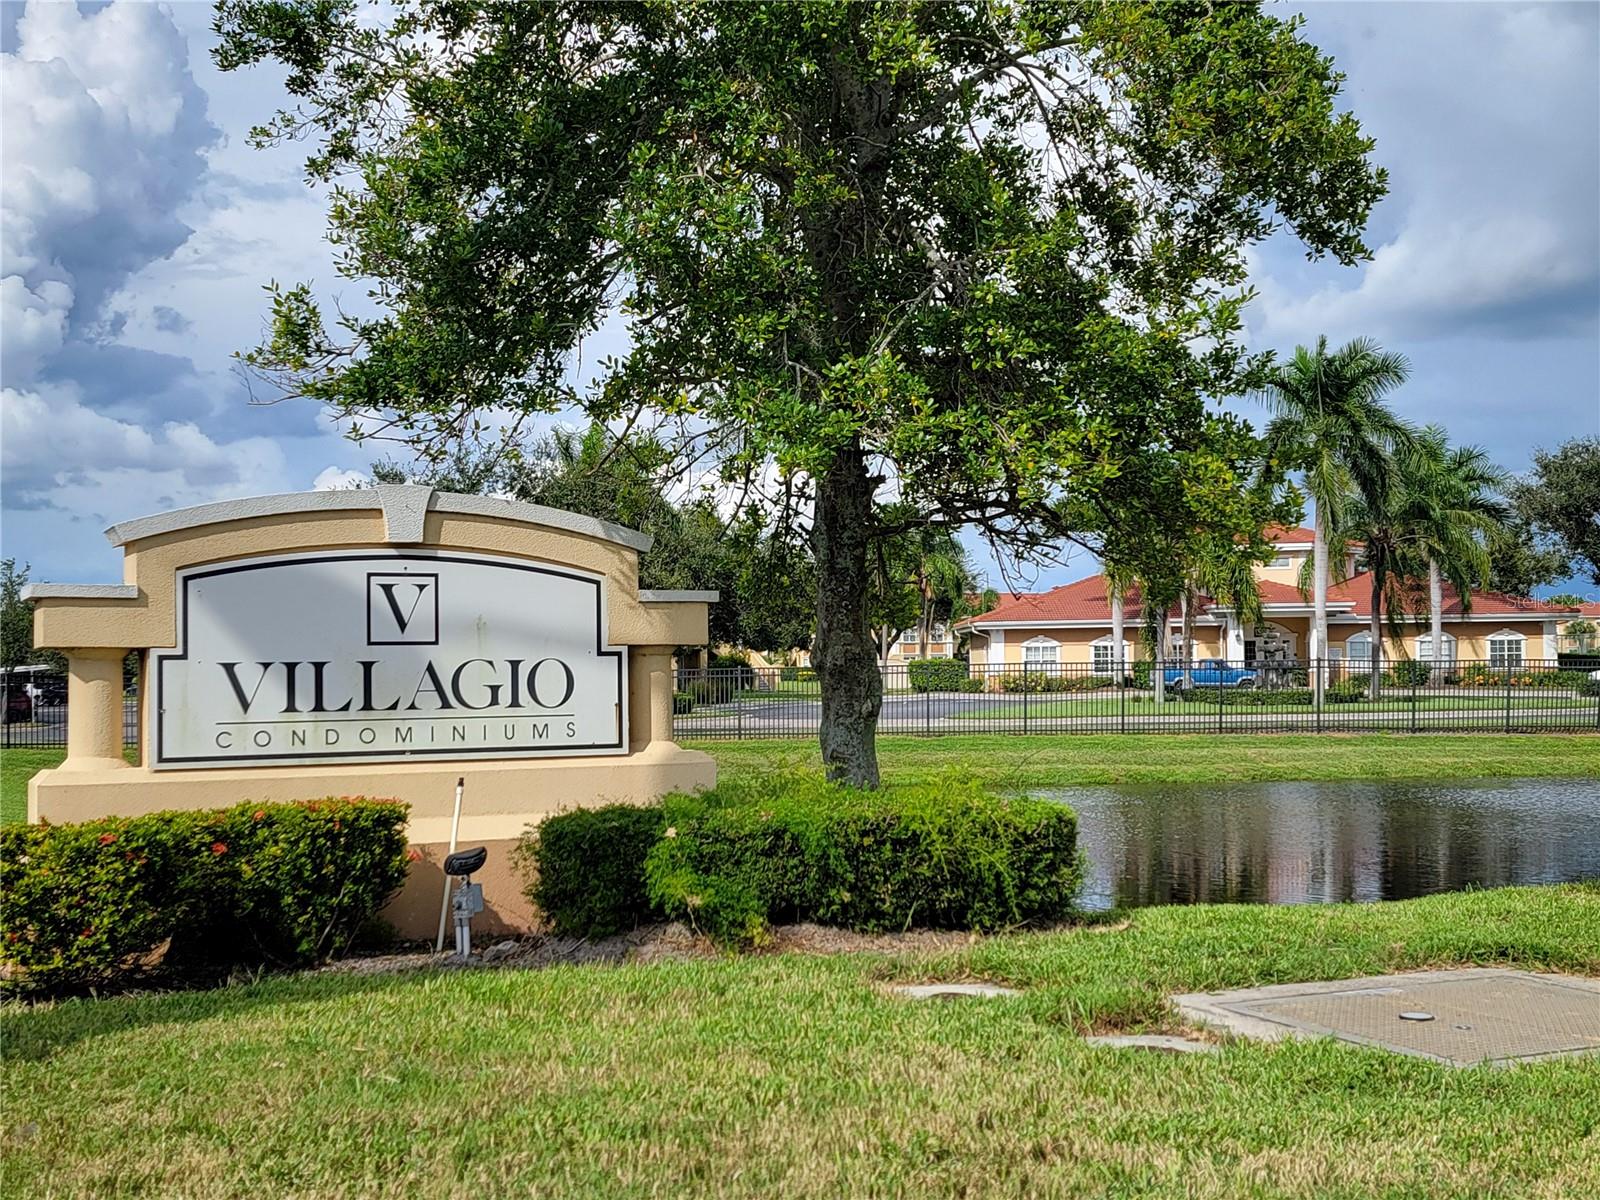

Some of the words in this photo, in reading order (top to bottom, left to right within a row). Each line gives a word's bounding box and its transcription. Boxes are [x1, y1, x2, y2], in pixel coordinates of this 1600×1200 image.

[377, 583, 429, 634] V
[217, 658, 575, 714] VILLAGIO
[215, 721, 576, 749] CONDOMINIUMS
